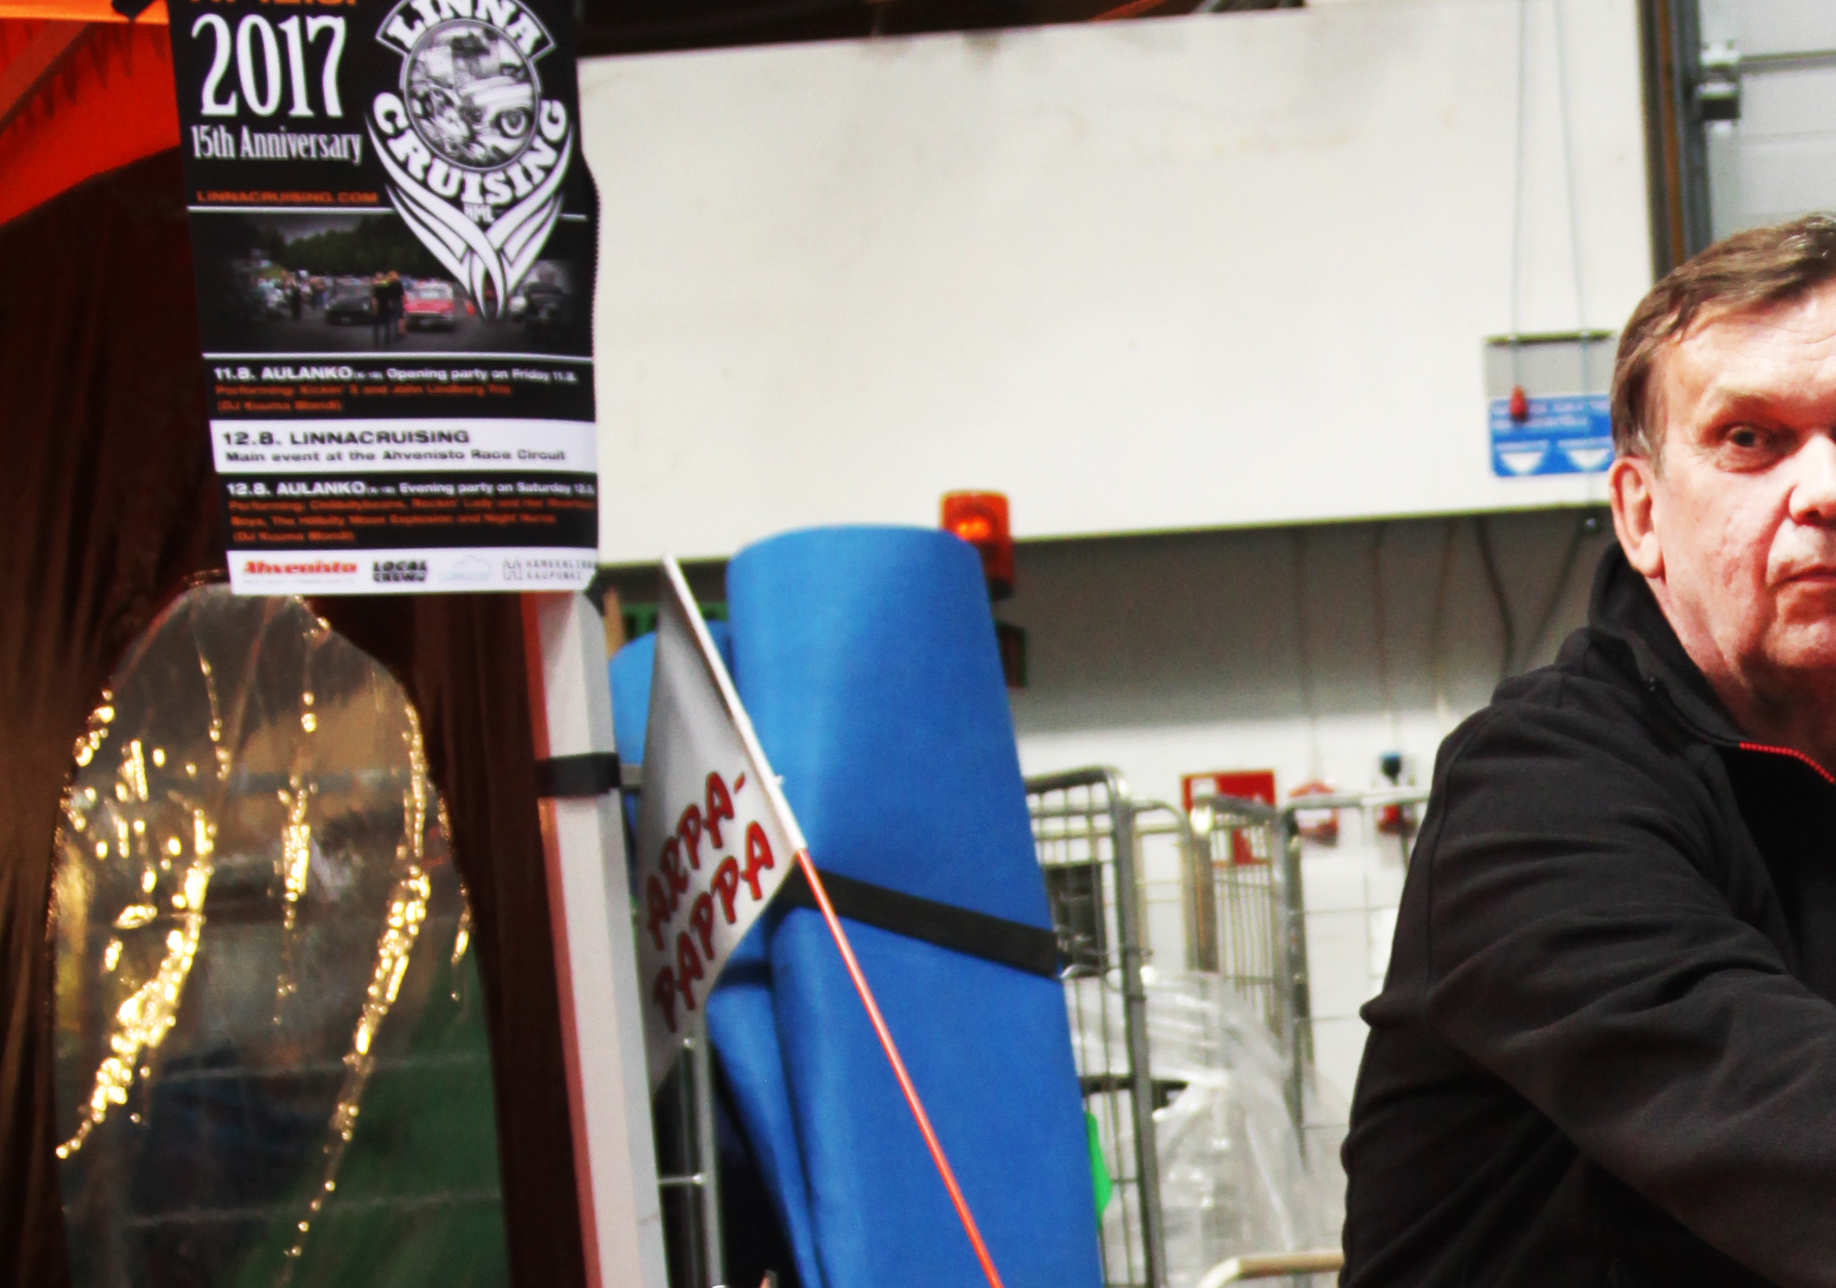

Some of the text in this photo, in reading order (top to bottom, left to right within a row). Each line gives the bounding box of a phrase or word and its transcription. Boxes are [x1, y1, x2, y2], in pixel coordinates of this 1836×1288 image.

[191, 13, 347, 118] 2017
[191, 124, 361, 167] 15th Anniversary
[373, 92, 568, 206] CRUISING
[261, 365, 352, 380] AULANKO
[386, 368, 447, 383] Opening
[451, 369, 488, 383] party
[492, 370, 508, 379] on
[511, 369, 550, 383] Friday
[289, 430, 470, 445] LINNACRUISING
[225, 449, 565, 462] Main event at the Ahvenisto Race Circuit
[277, 481, 366, 496] AULANKO
[399, 482, 454, 496] Evening
[458, 483, 493, 496] party
[497, 484, 513, 493] on
[517, 481, 571, 495] Saturday
[244, 560, 358, 574] Ahvenisto
[653, 820, 775, 1034] PAPPA
